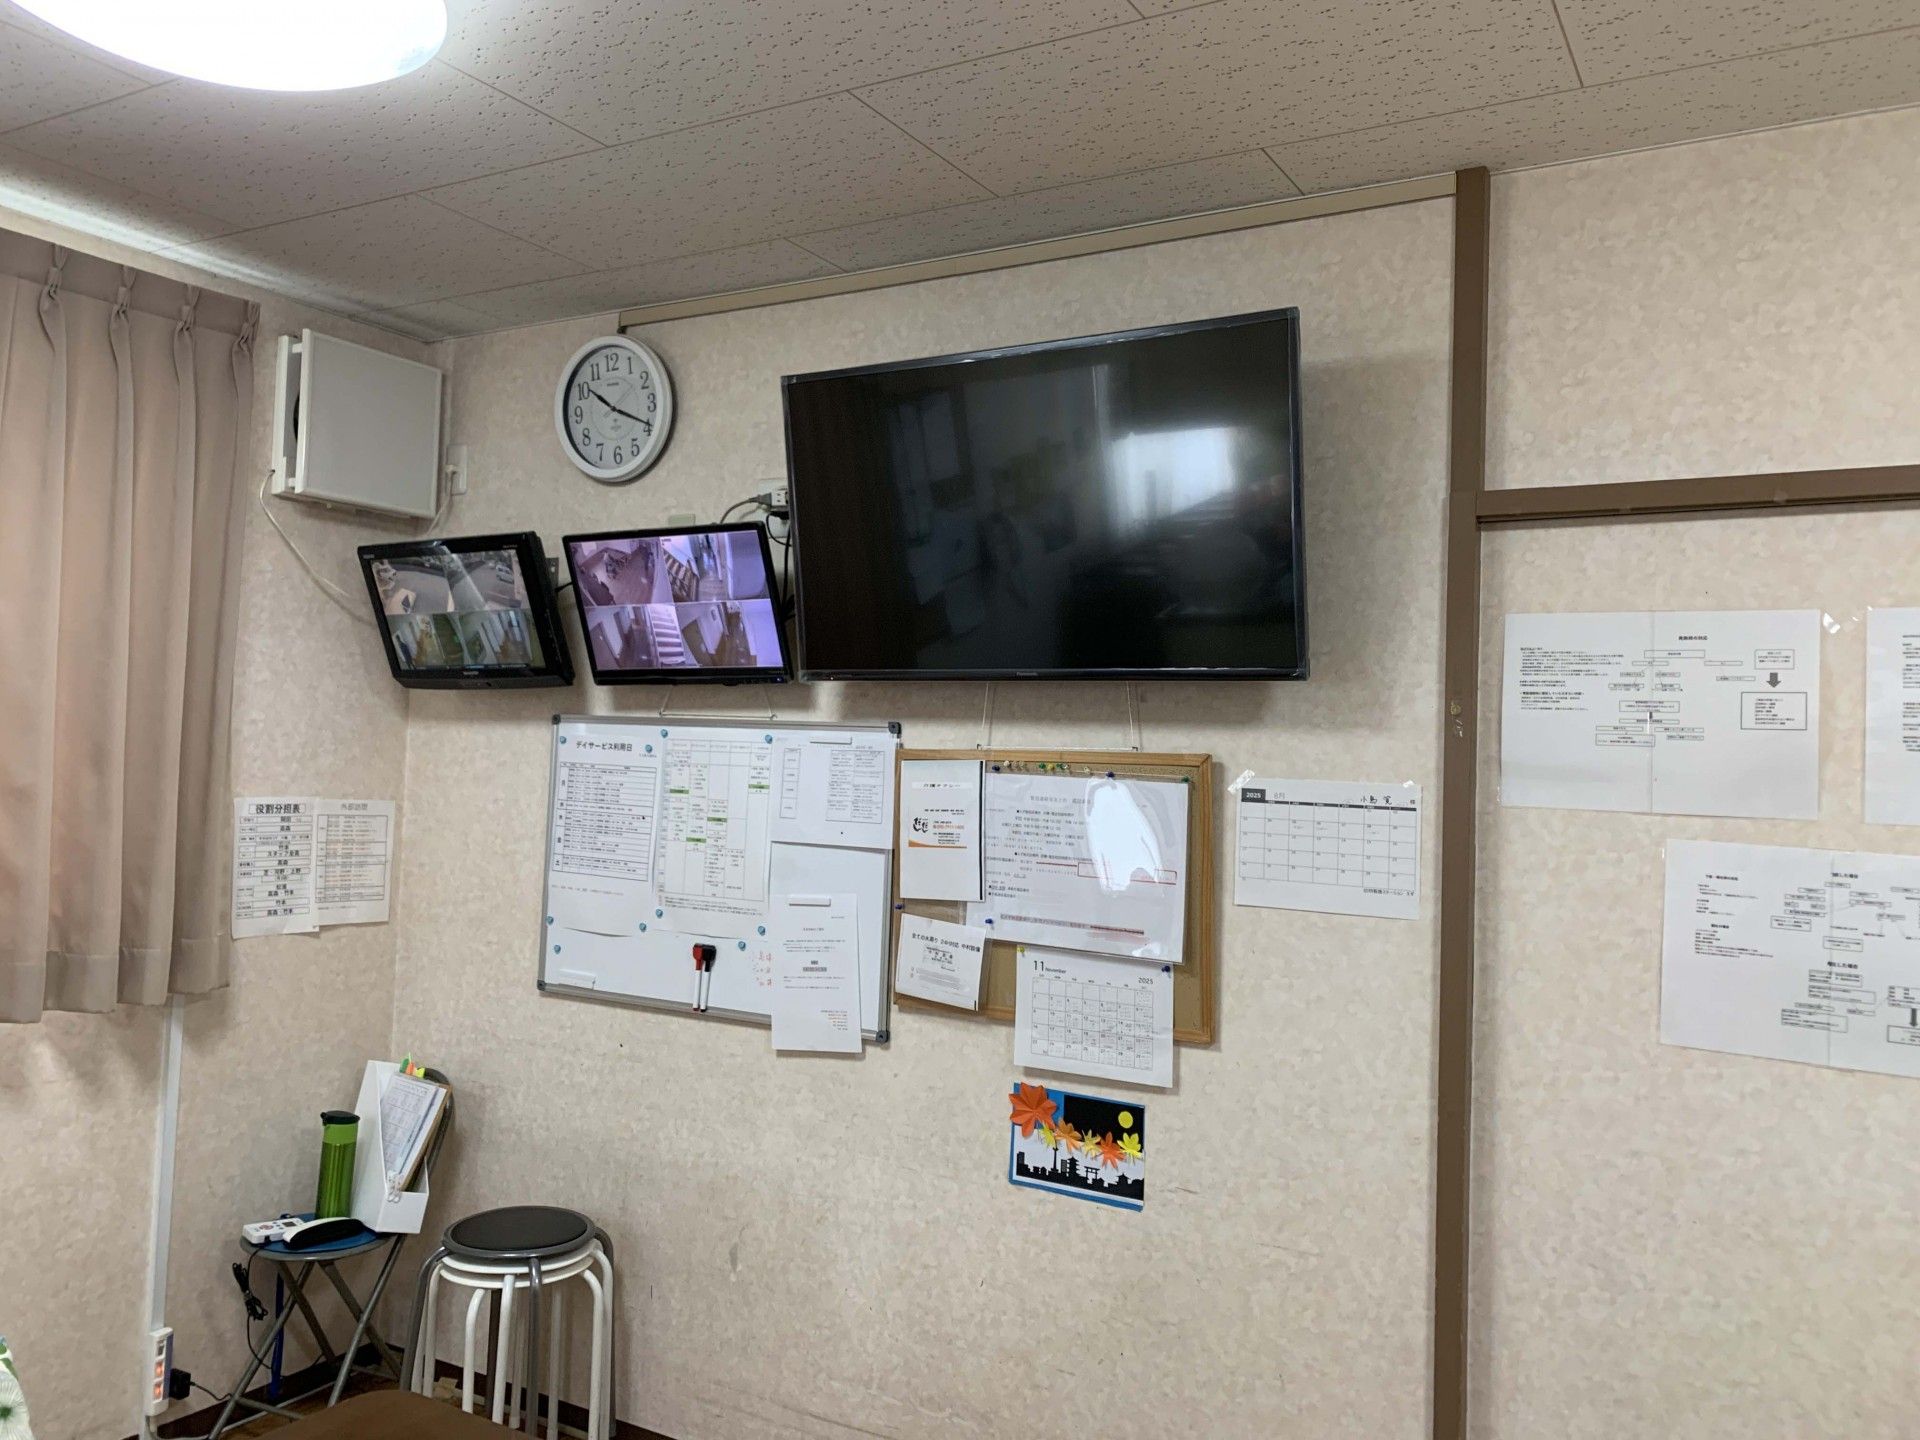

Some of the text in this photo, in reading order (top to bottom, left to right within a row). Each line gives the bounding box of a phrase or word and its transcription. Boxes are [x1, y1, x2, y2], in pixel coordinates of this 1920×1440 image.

[590, 362, 601, 381] 11
[604, 353, 619, 372] 12
[627, 357, 633, 374] 1
[640, 371, 649, 389] 2
[578, 382, 590, 400] 10
[647, 393, 656, 412] 3
[574, 406, 583, 424] 9
[643, 418, 653, 437] 4
[582, 428, 591, 446] 8
[596, 443, 604, 461] 7
[613, 446, 622, 464] 6
[631, 438, 640, 457] 5
[576, 741, 632, 751] デイサービス利用日
[256, 804, 300, 814] 役割分担表
[1034, 960, 1044, 971] 11
